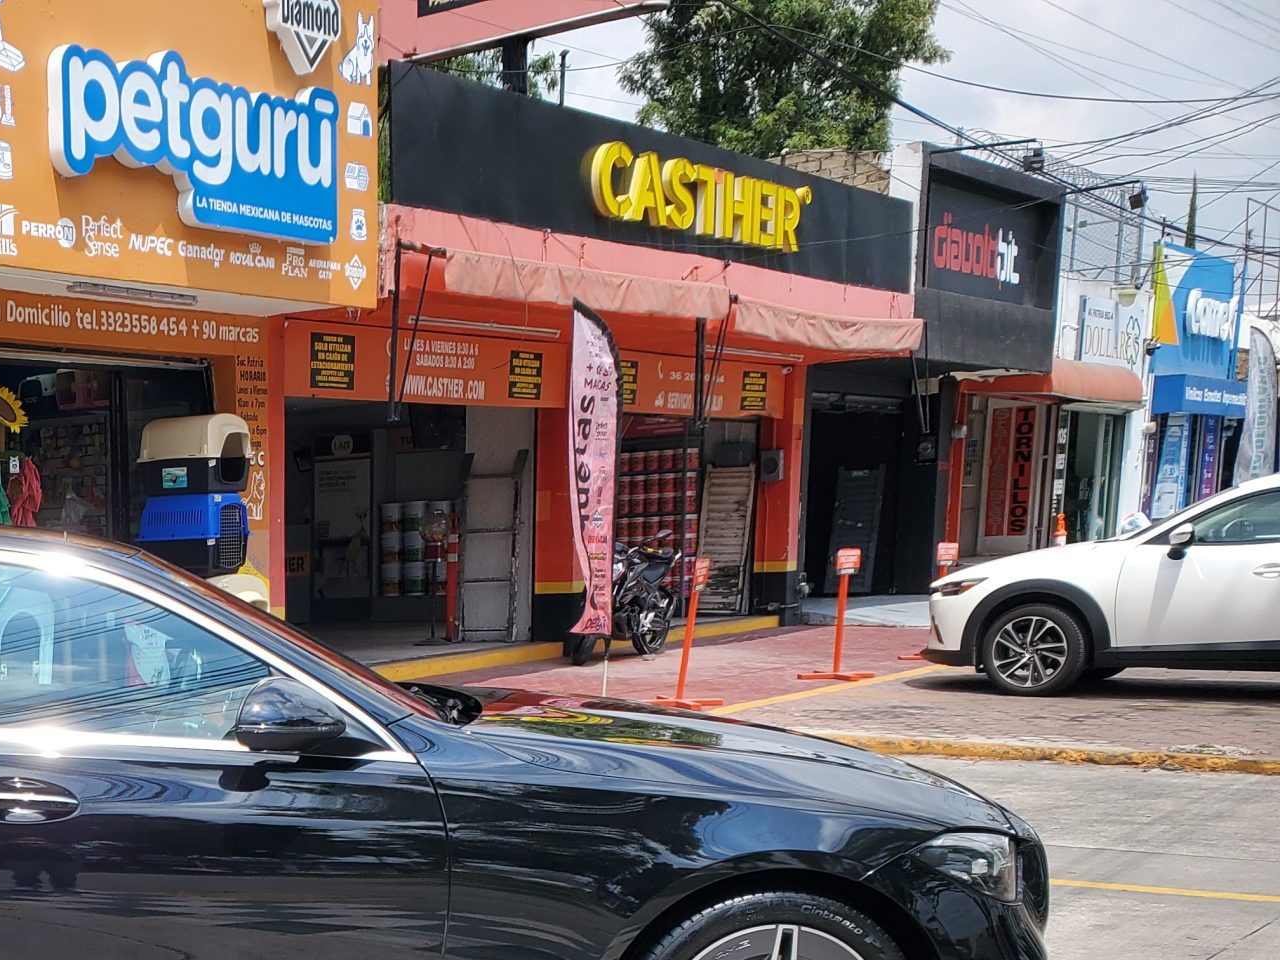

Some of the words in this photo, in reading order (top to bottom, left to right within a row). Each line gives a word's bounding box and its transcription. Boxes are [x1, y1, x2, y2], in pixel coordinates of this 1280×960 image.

[196, 196, 207, 208] LA
[209, 198, 238, 214] TIENDA
[240, 203, 280, 223] MEXICANA
[281, 212, 291, 223] DE
[293, 213, 332, 231] MASCOTAS
[81, 215, 123, 238] Perfect
[85, 232, 120, 257] Sense
[128, 234, 173, 257] NUPEC
[178, 240, 225, 262] Ganador
[230, 251, 254, 267] ROYAL
[286, 253, 305, 266] PRO
[281, 264, 308, 278] PLAN
[6, 303, 71, 328] Domicilio
[203, 319, 217, 340] 90
[220, 324, 260, 344] marcas
[431, 339, 456, 354] VIERNES
[457, 341, 469, 354] 8:30
[247, 356, 264, 368] Patria
[445, 356, 457, 368] 8:30
[240, 371, 266, 382] HORARIO
[1010, 406, 1037, 532] TORNILLOS
